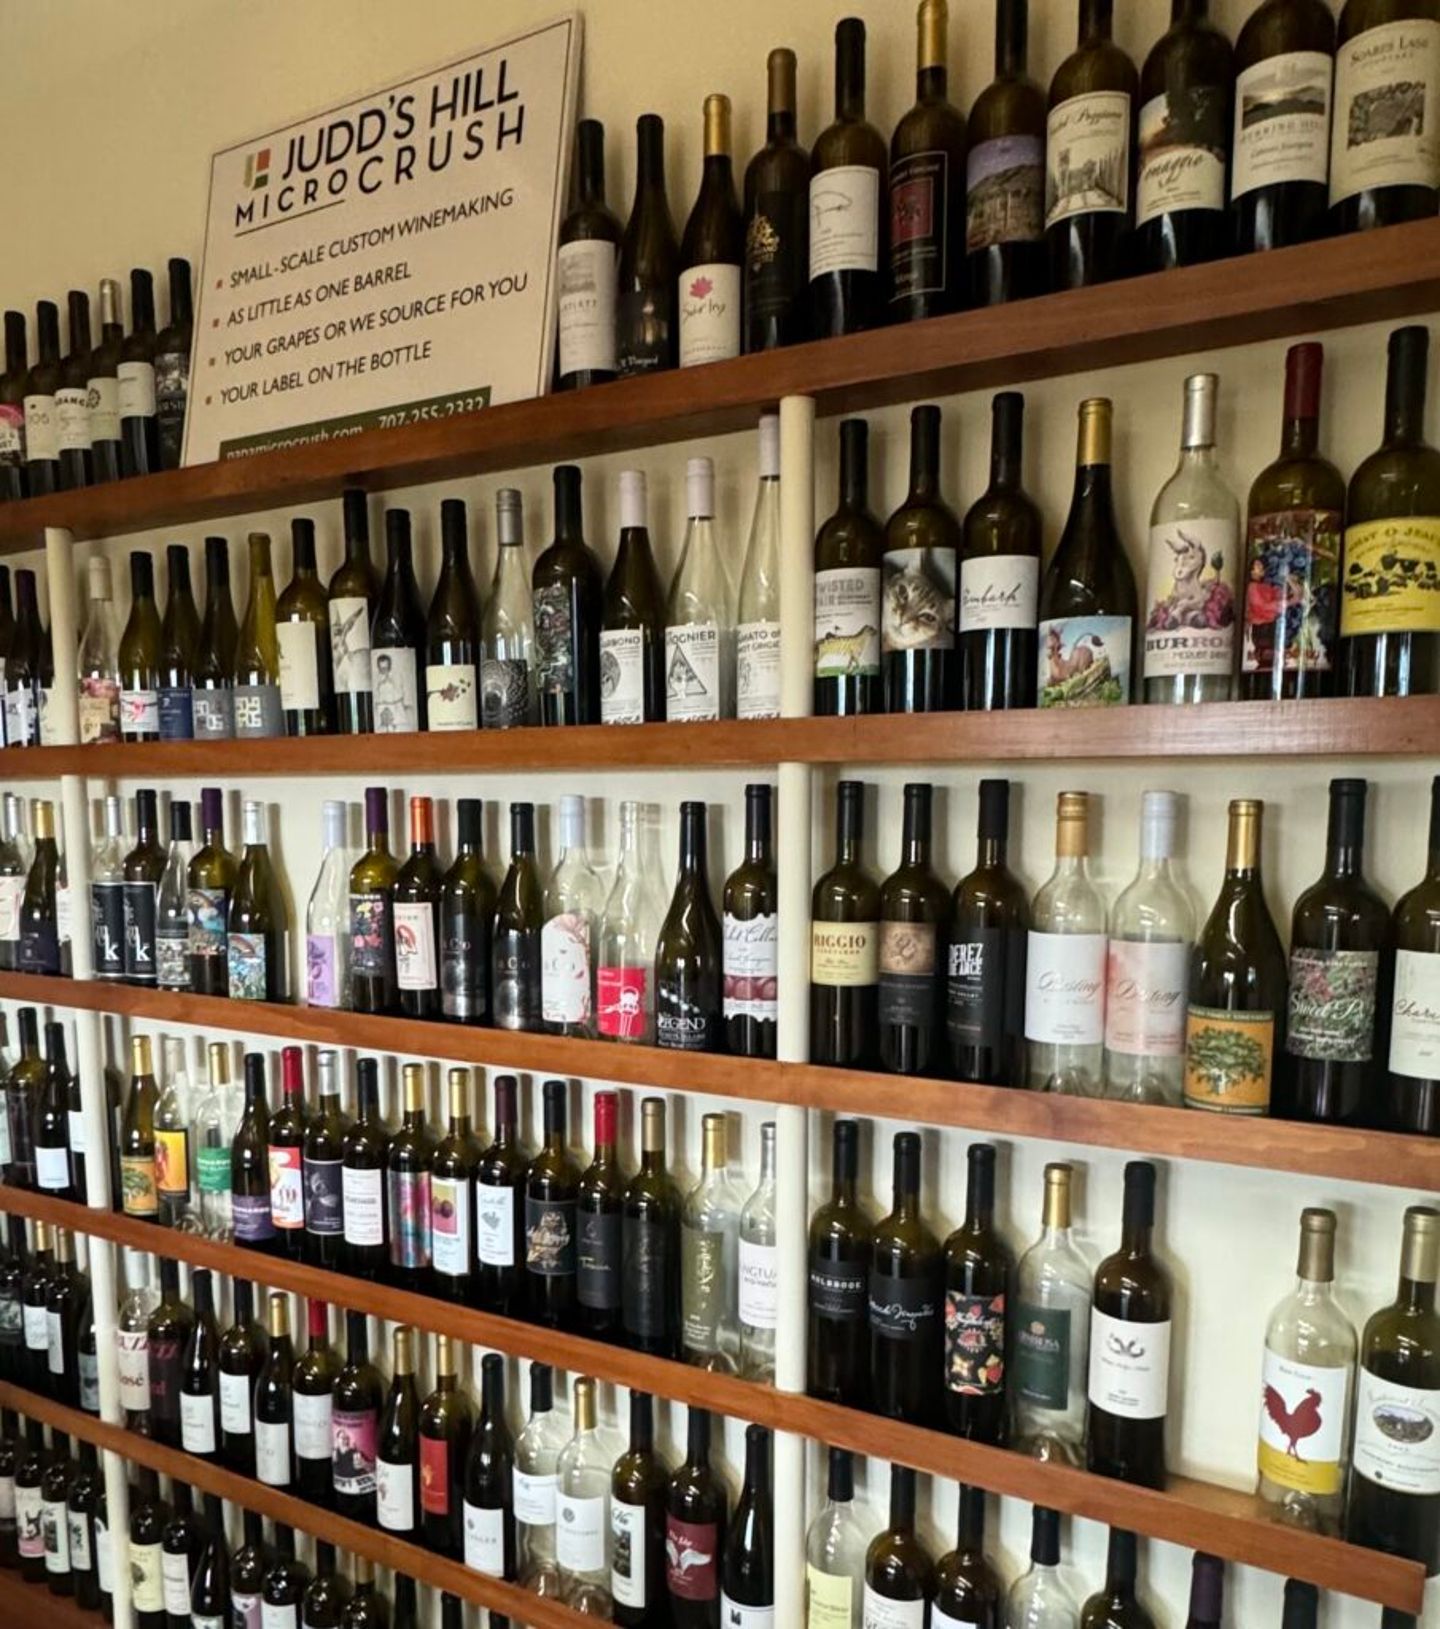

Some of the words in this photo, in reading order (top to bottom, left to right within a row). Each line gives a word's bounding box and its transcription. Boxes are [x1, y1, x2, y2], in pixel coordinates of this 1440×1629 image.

[282, 95, 415, 180] JUDD'S
[429, 60, 519, 128] HILL
[230, 245, 325, 288] SMALL-SCALE
[329, 224, 395, 258] CUSTOM
[397, 188, 514, 238] WINEMAKING
[224, 342, 262, 365] YOUR
[266, 326, 320, 355] GRAPES
[324, 320, 347, 341] OR
[350, 312, 376, 333] WE
[379, 294, 447, 327] SOURCE
[451, 284, 485, 309] FOR
[488, 272, 528, 299] YOU
[227, 308, 244, 328] AS
[248, 295, 293, 321] LITTLE
[294, 289, 312, 308] AS
[316, 278, 350, 302] ONE
[354, 261, 412, 292] BARREL
[221, 382, 259, 404] YOUR
[262, 371, 303, 395] LABEL
[308, 364, 334, 384] ON
[337, 356, 367, 379] THE
[370, 340, 432, 371] BOTTLE
